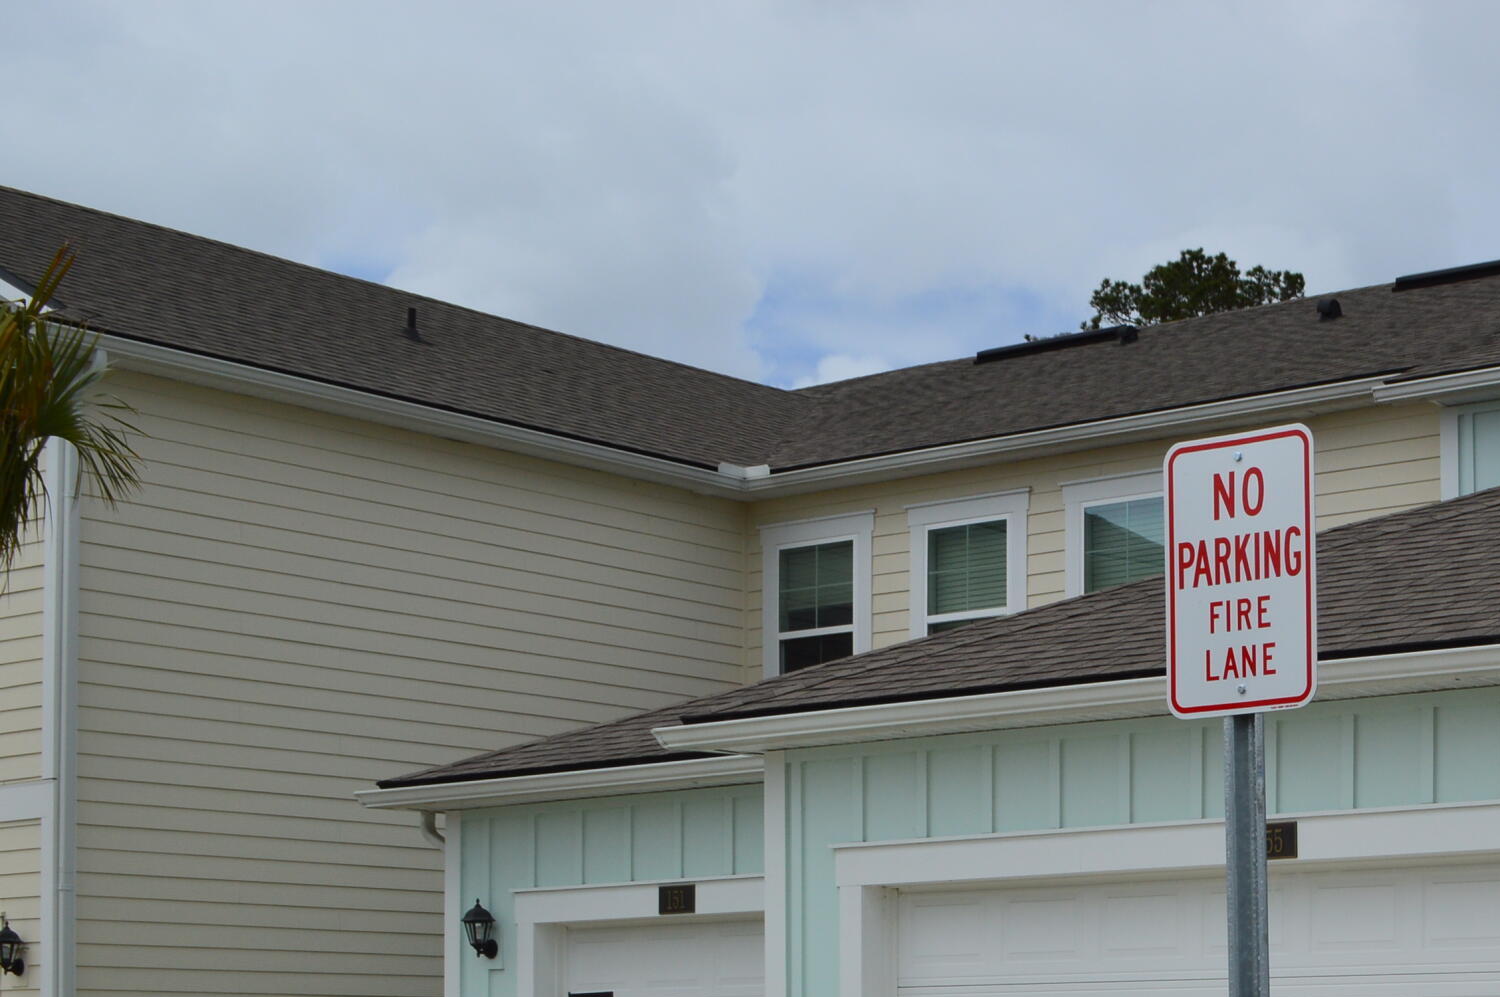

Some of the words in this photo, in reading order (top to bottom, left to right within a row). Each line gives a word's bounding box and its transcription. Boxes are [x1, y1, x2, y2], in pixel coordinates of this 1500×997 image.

[1213, 466, 1265, 521] NO
[1178, 525, 1302, 590] PARKING
[1209, 595, 1271, 634] FIRE
[1205, 642, 1277, 682] LANE
